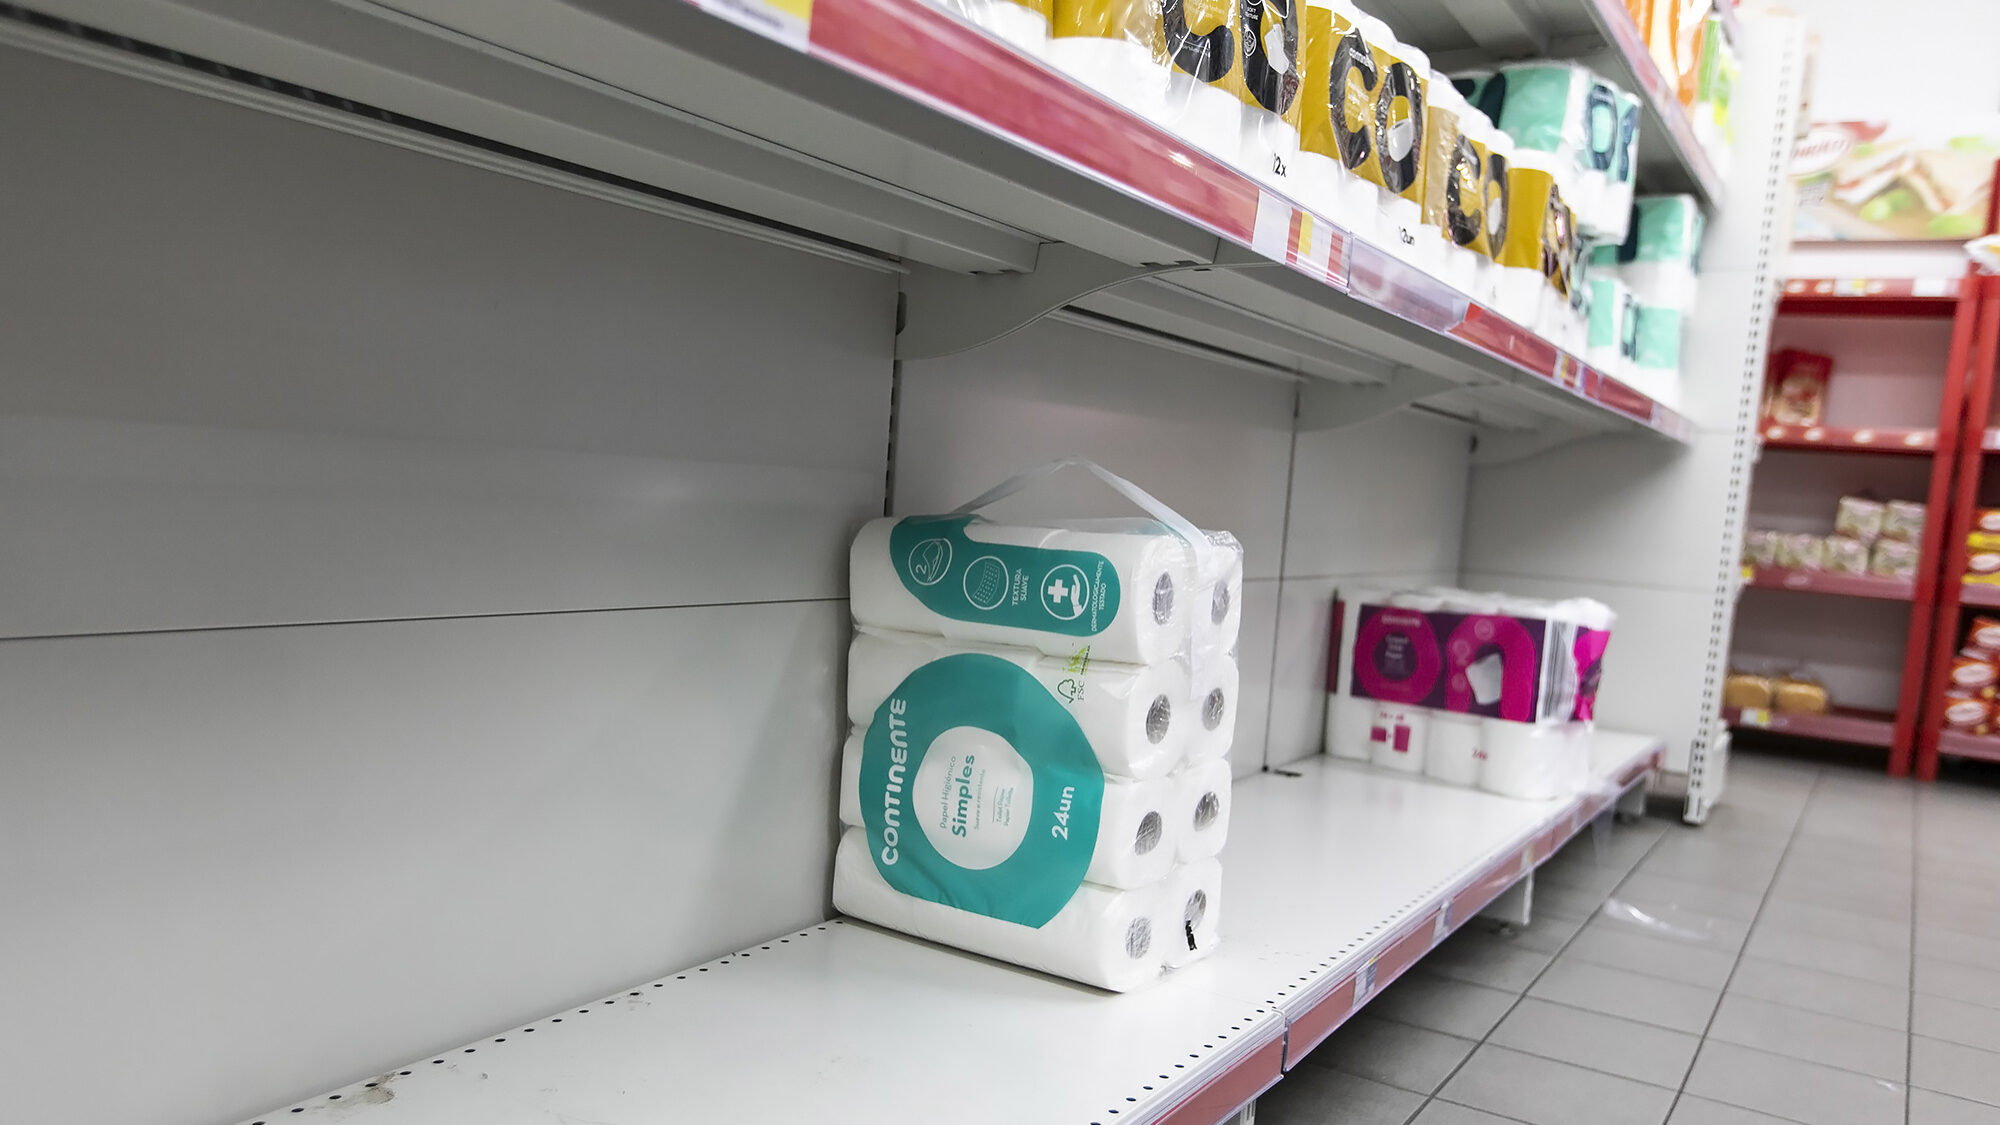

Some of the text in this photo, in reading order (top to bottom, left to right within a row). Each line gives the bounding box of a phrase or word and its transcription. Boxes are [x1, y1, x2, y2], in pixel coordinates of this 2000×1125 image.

[1399, 226, 1415, 246] 2un
[1012, 568, 1023, 606] TEXTURA
[1020, 575, 1030, 602] SUAVE
[1099, 583, 1107, 610] TESTADO
[881, 698, 908, 866] CONTINENTE
[939, 755, 957, 829] Papel Higiénico
[951, 754, 975, 838] Simples
[1051, 785, 1075, 841] 24un
